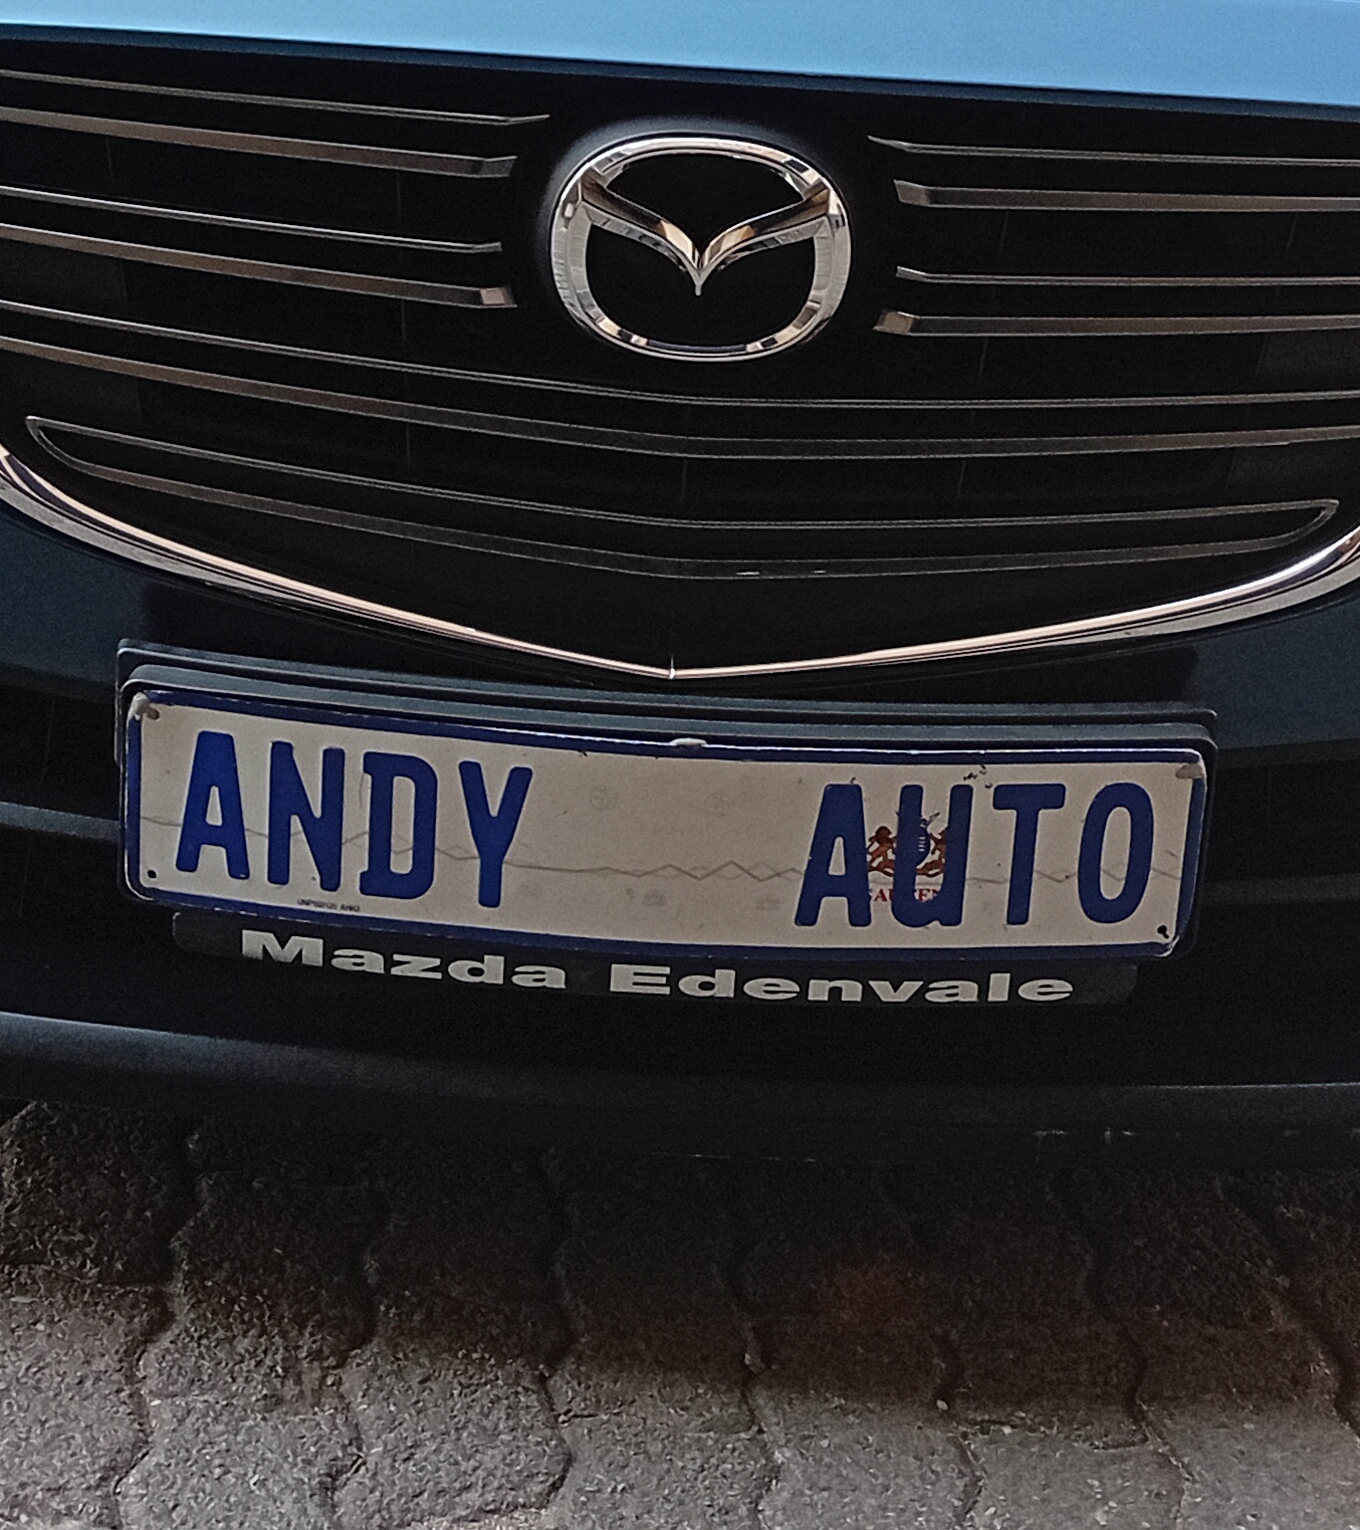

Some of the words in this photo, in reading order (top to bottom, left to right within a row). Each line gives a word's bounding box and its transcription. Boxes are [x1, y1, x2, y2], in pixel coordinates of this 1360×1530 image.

[175, 730, 533, 908] ANDY
[794, 782, 1154, 927] AUTO
[242, 929, 566, 989] Mazda
[610, 963, 1074, 1003] Edenvale
